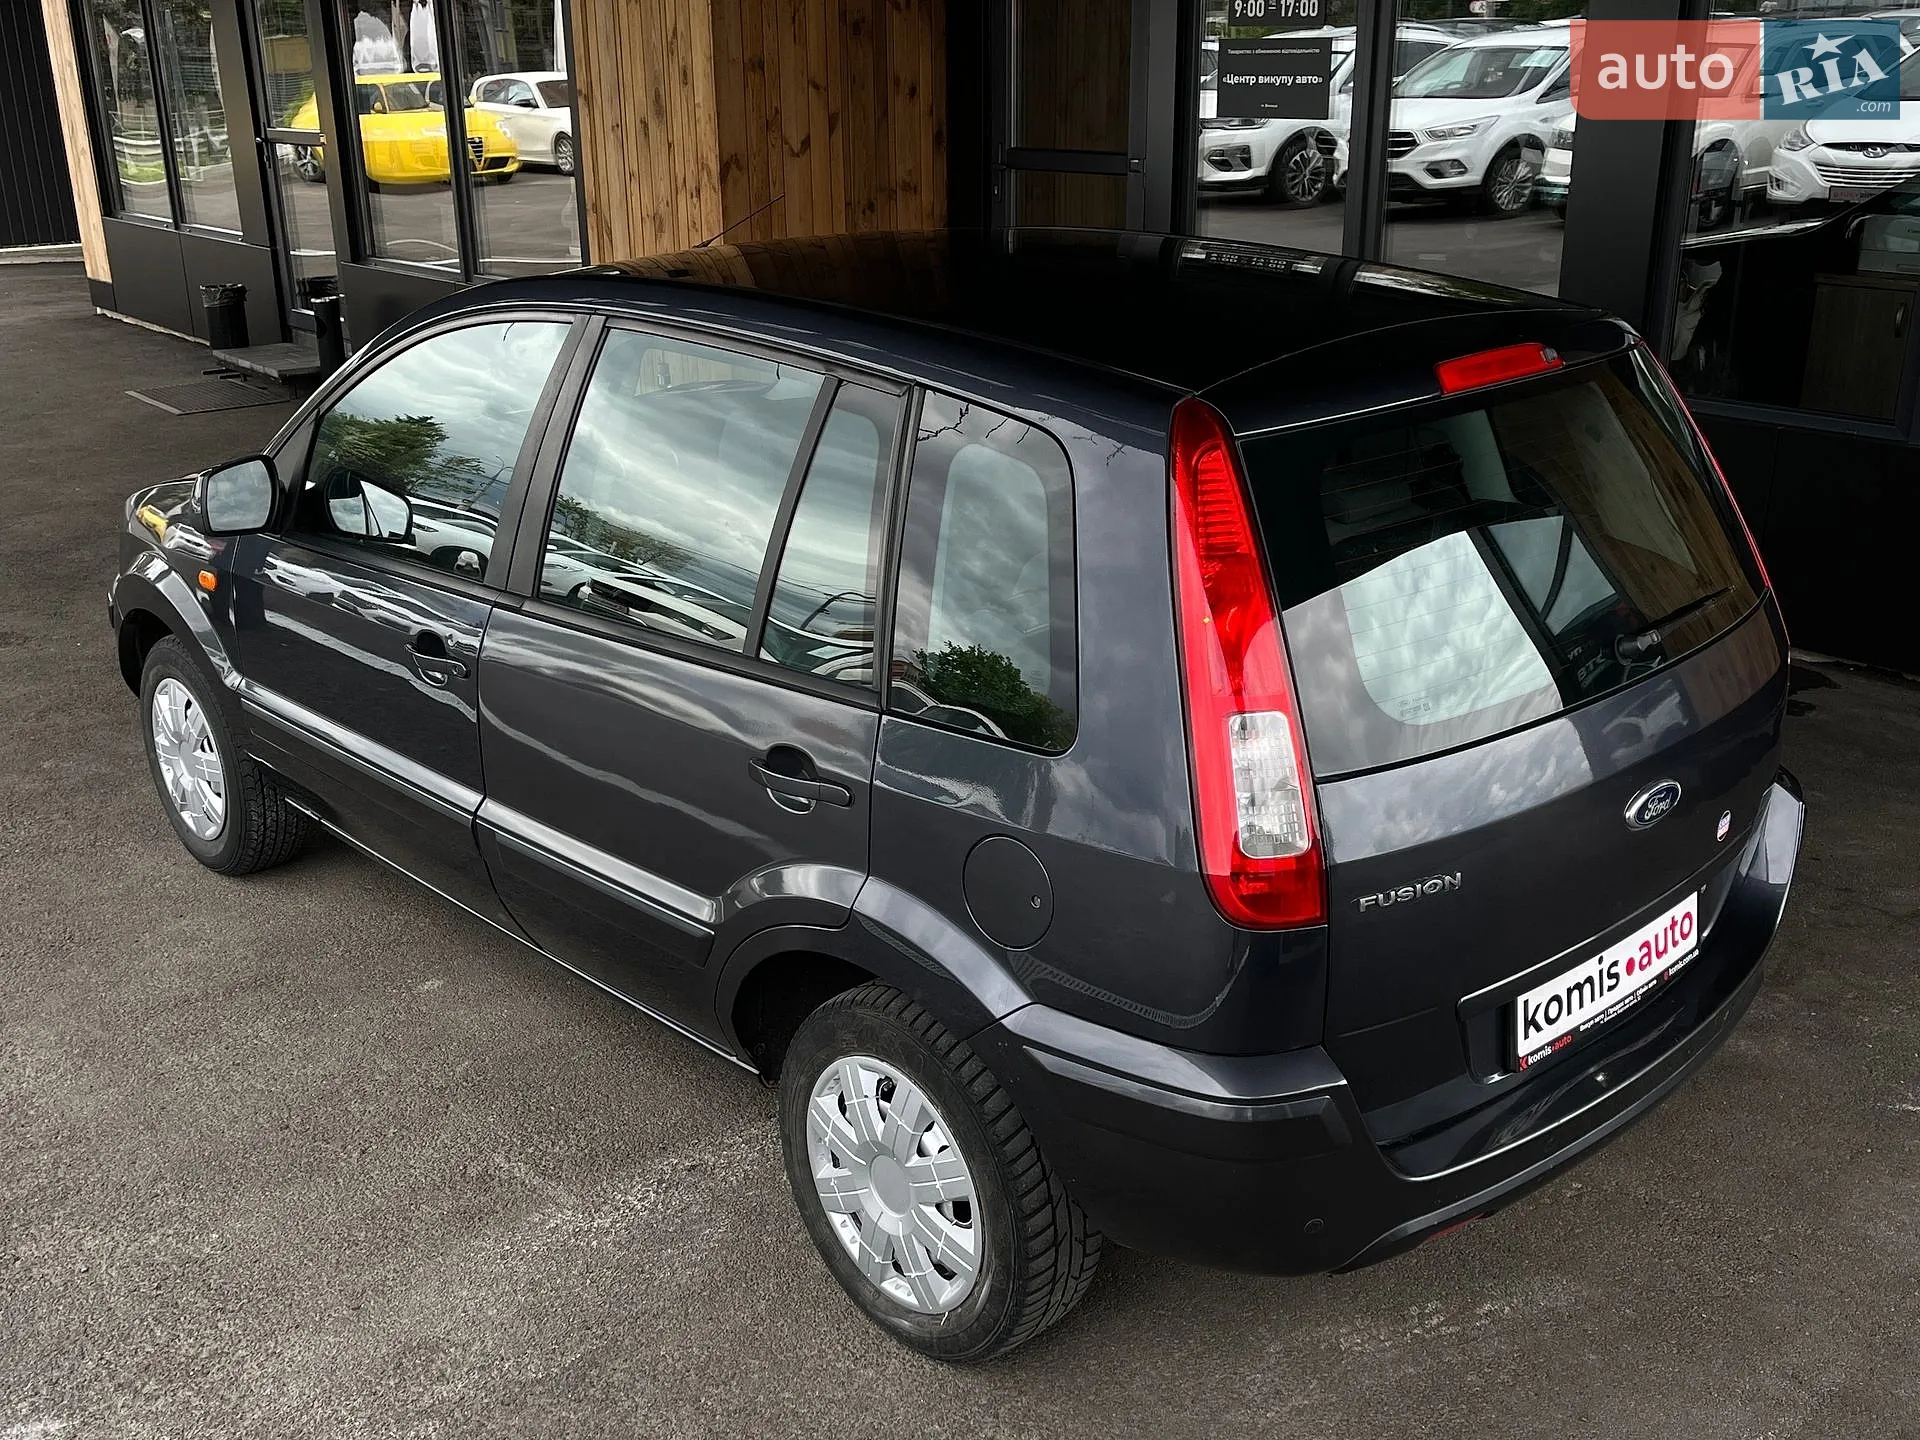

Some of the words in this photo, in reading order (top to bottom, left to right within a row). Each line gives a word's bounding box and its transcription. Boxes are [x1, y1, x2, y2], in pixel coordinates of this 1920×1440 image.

[1234, 0, 1265, 17] 9:00
[1280, 0, 1319, 17] 17:00
[1223, 74, 1257, 86] «Центр
[1258, 75, 1294, 86] викупу
[1295, 75, 1323, 84] авто»
[1644, 791, 1673, 821] Ford
[1359, 872, 1462, 913] FUSION
